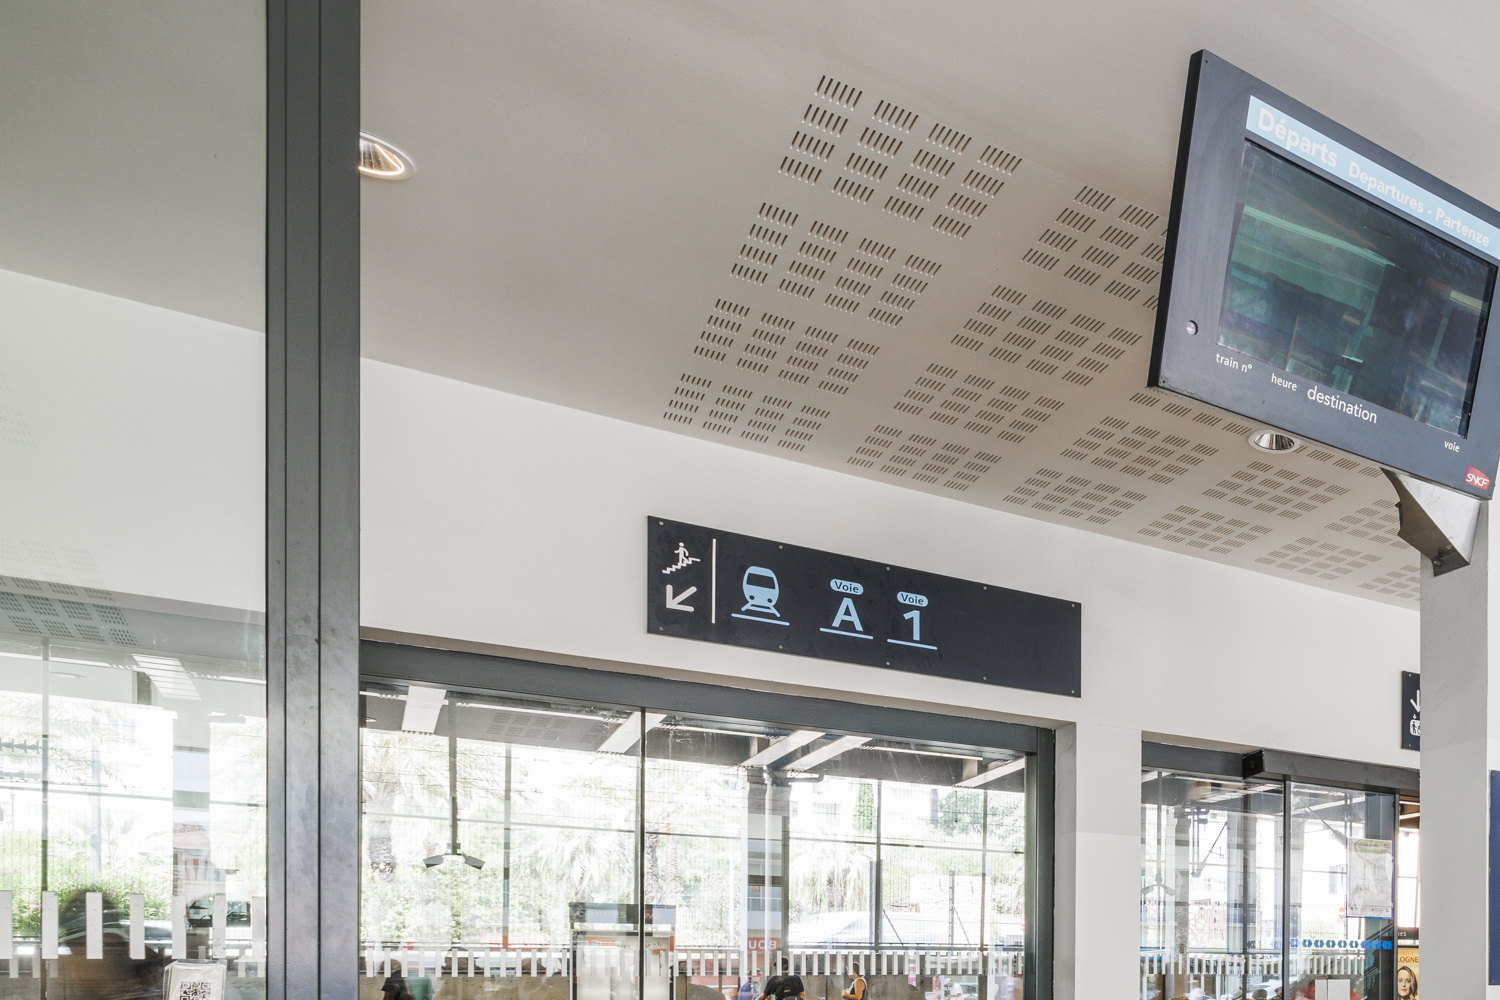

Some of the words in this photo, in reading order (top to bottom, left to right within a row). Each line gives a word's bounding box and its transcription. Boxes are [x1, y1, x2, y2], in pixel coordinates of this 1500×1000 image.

[1258, 107, 1338, 168] Départs
[1348, 161, 1424, 214] Departures
[1435, 207, 1490, 247] Partenze
[1216, 353, 1239, 369] train
[1271, 373, 1297, 391] heure
[1307, 385, 1377, 424] destination
[1444, 440, 1460, 453] voie
[1465, 473, 1490, 487] SNCF
[834, 580, 859, 593] Voie
[901, 593, 924, 605] Voie
[831, 597, 864, 632] A
[903, 609, 920, 641] 1
